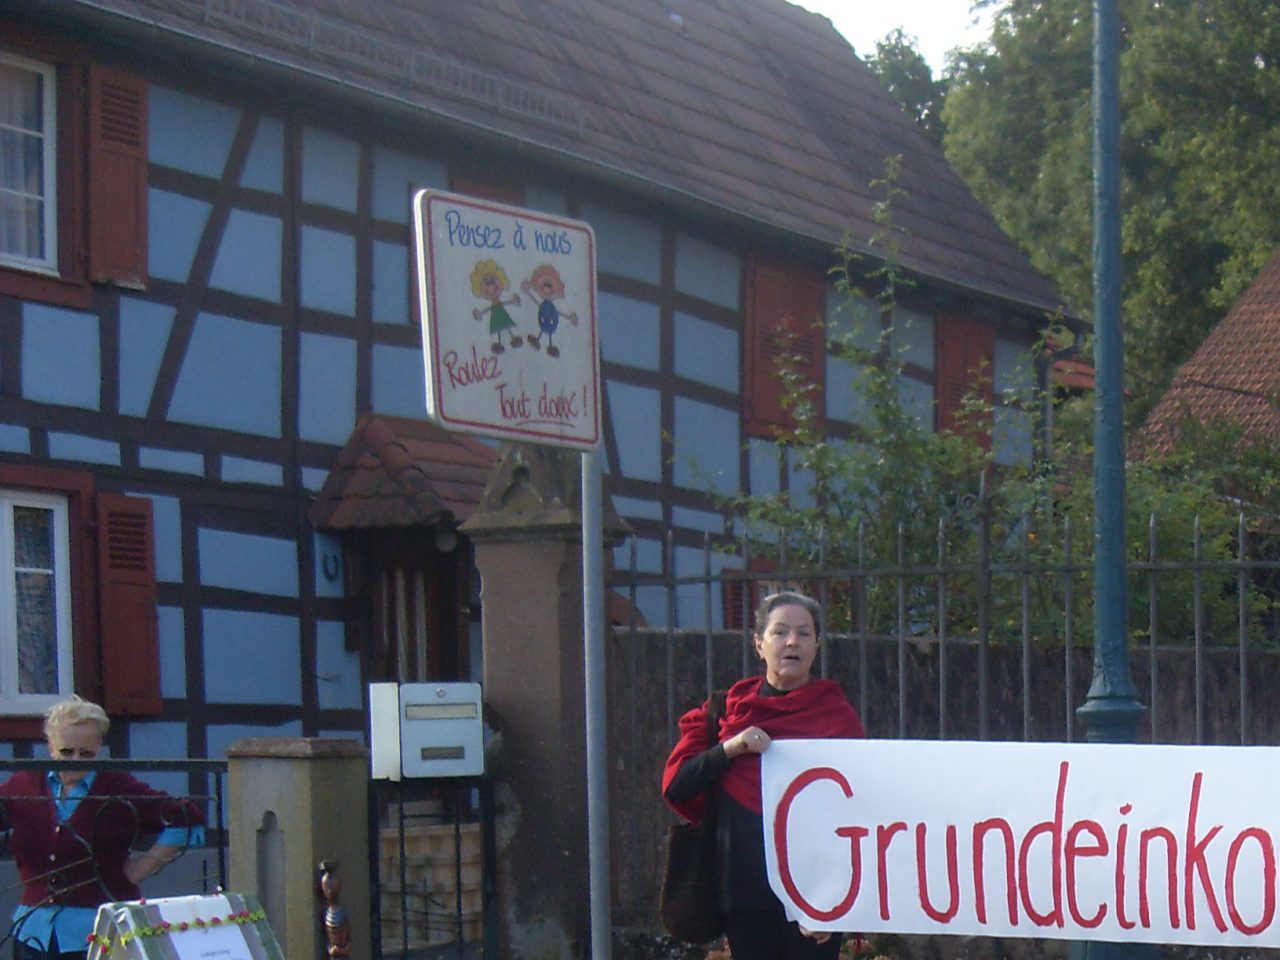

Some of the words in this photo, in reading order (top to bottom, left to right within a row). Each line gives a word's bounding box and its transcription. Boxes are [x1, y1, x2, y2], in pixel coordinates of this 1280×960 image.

[444, 209, 505, 250] Pensez
[513, 221, 527, 250] à
[535, 229, 572, 255] nous
[443, 345, 503, 389] Roulez
[494, 383, 531, 419] Tout
